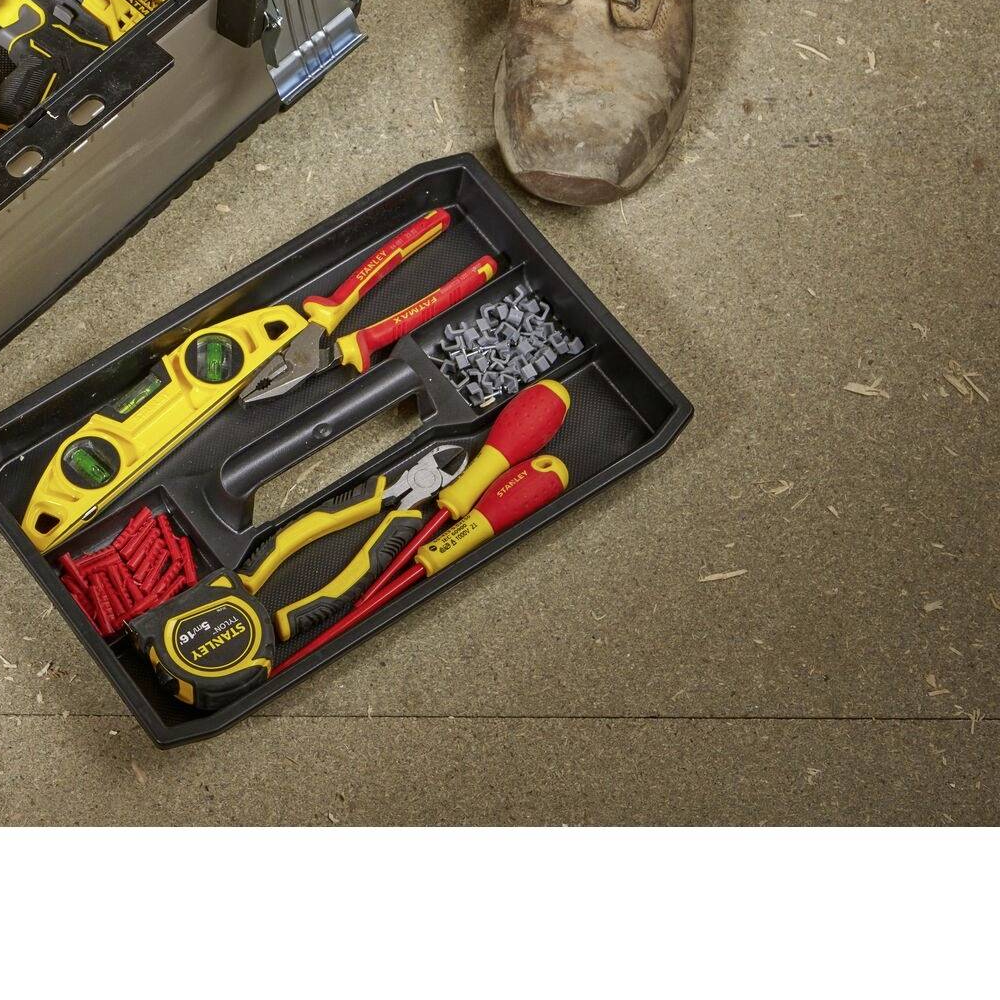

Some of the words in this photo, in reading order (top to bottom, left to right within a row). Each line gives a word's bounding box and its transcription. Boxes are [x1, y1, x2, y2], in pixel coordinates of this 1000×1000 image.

[356, 250, 388, 281] STANLEY
[393, 296, 438, 324] FATMAX
[496, 470, 529, 498] STANLEY
[191, 622, 246, 661] STANLEY
